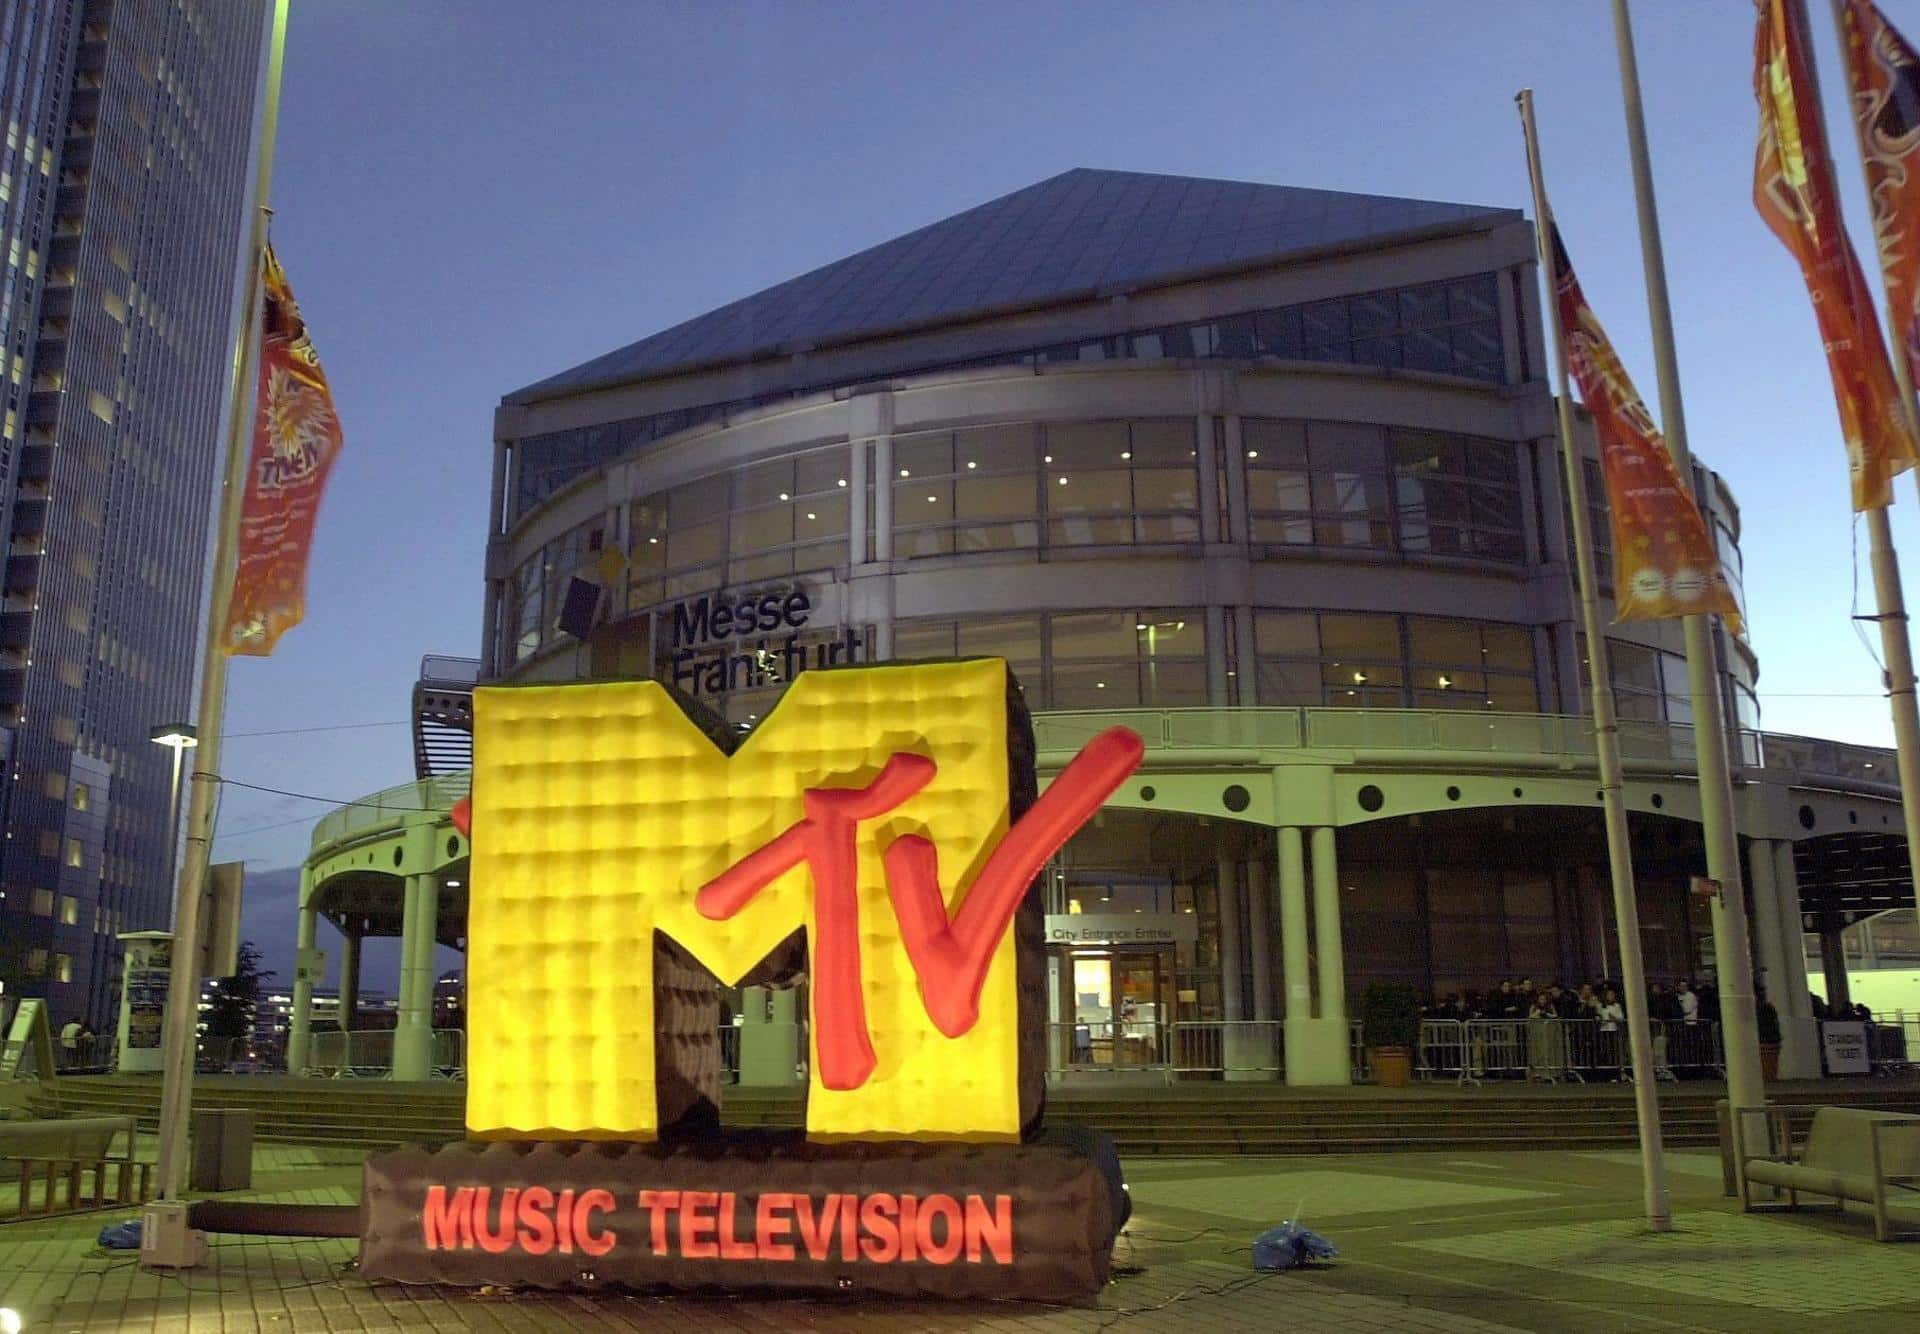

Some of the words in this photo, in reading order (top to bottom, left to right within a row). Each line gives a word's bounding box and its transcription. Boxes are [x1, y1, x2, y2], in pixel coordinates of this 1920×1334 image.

[673, 591, 811, 648] Messe
[466, 656, 1145, 1143] MTV
[1052, 928, 1076, 941] City
[1082, 928, 1131, 939] Entrance
[423, 1185, 616, 1256] MUSIC
[639, 1190, 1014, 1264] TELEVISION
